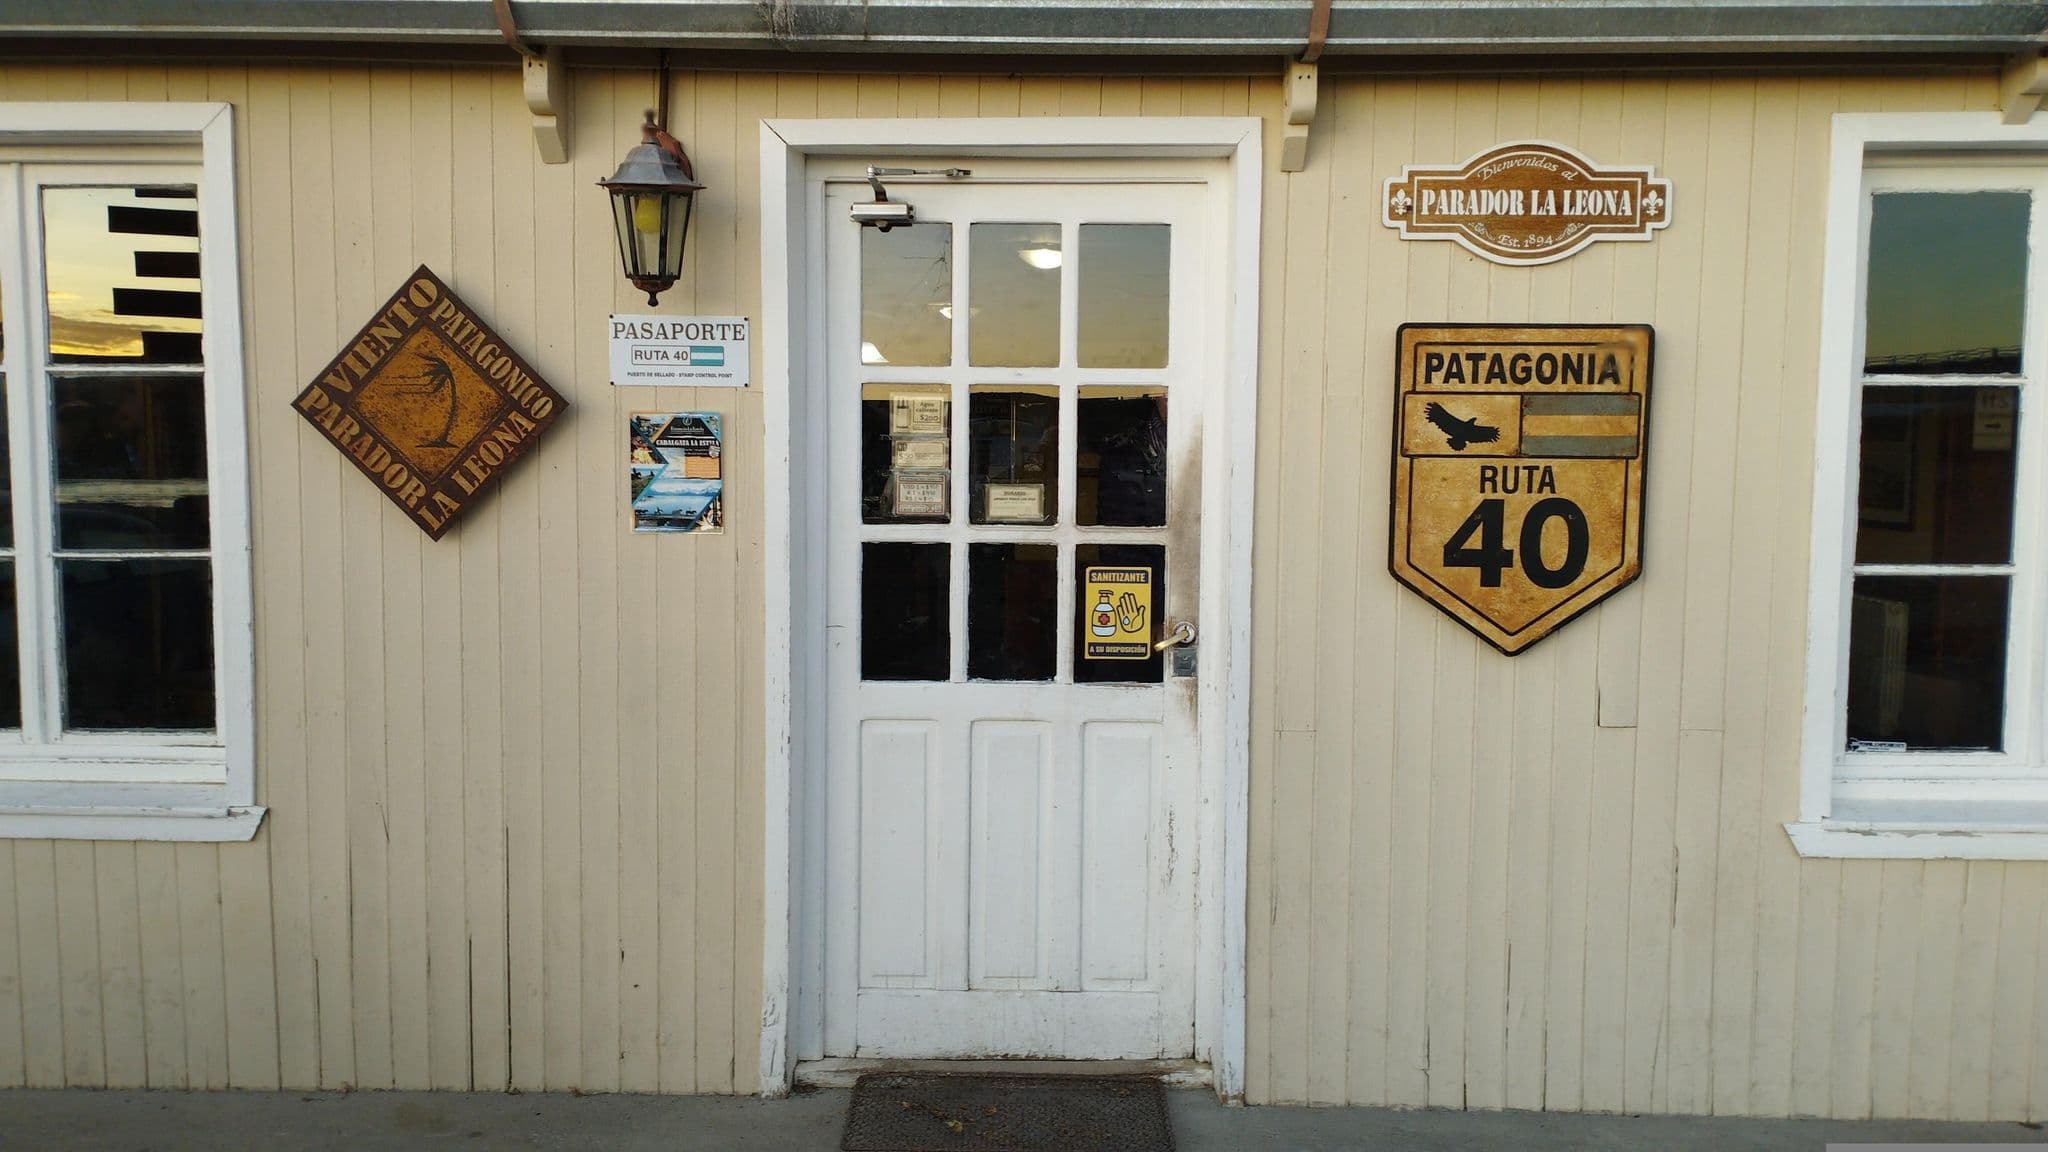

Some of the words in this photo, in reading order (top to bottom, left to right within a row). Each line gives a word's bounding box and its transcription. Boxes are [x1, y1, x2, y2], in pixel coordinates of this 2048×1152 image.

[1477, 157, 1559, 180] Bienvenidos
[1561, 170, 1578, 181] al
[1421, 189, 1525, 216] PARADOR
[1530, 189, 1557, 216] LA
[1562, 189, 1633, 216] LEONA
[1498, 234, 1521, 248] Est.
[1523, 233, 1553, 248] 1894
[323, 278, 438, 396] VIENTO
[612, 321, 746, 341] PASAPORTE
[428, 297, 553, 420] PATAGONICO
[634, 350, 669, 361] RUTA
[673, 350, 689, 361] 40
[1423, 352, 1621, 386] PATAGONIA
[299, 384, 427, 509] PARADOR
[417, 490, 461, 531] LA
[451, 410, 536, 496] LEONA
[1479, 465, 1557, 494] RUTA
[1443, 497, 1590, 589] 40
[1091, 572, 1146, 582] SANITIZANTE
